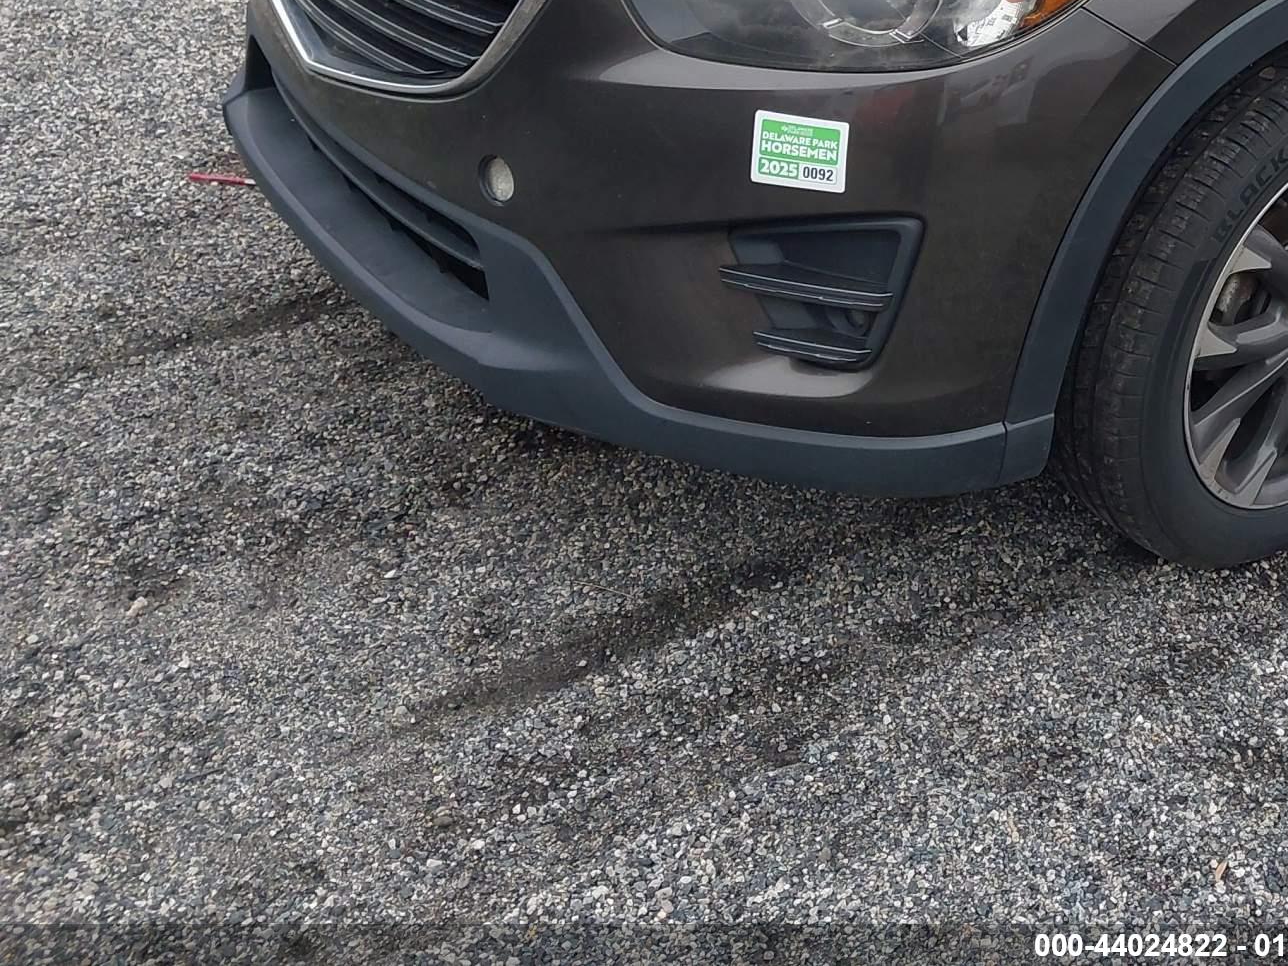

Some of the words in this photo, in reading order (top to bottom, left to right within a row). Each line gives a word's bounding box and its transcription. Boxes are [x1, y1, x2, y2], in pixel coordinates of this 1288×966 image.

[761, 139, 838, 162] HORSEMEN
[762, 131, 811, 147] DELAWARE
[812, 137, 838, 150] PARK
[759, 158, 798, 177] 2025
[802, 166, 834, 182] 0092
